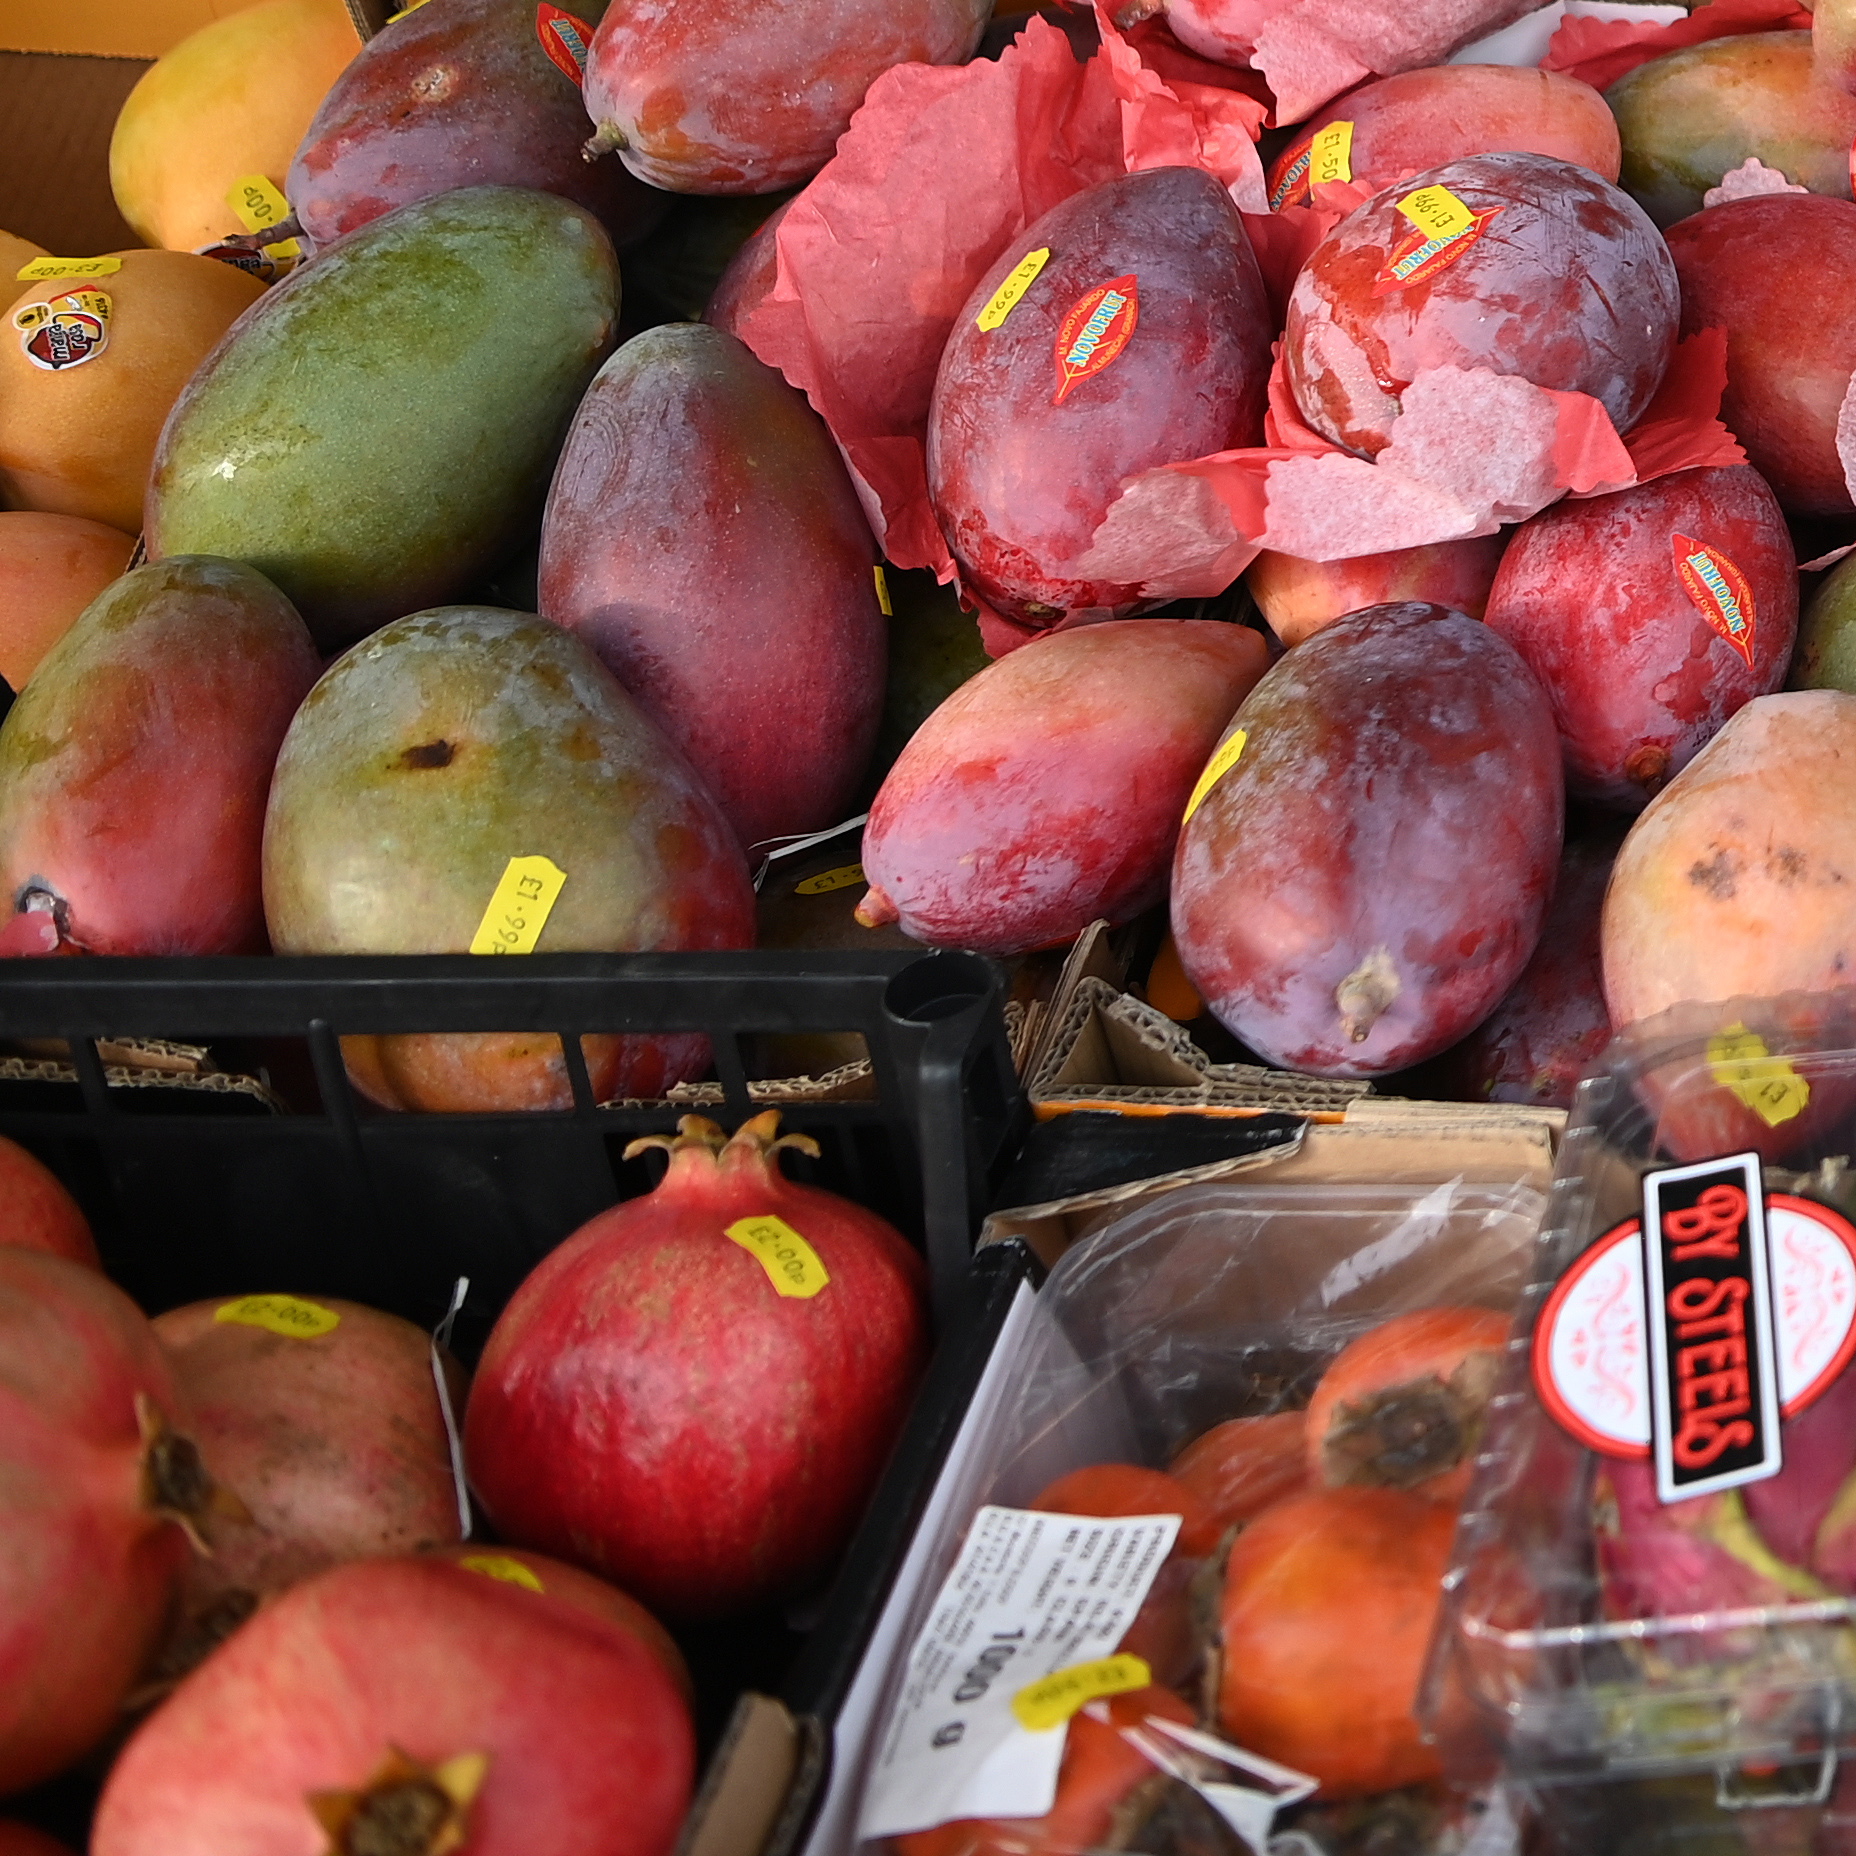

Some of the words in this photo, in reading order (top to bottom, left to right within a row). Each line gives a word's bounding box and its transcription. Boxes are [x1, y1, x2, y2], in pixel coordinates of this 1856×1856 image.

[1065, 289, 1128, 368] NOVOFRUT
[1684, 550, 1749, 636] NOVOFRUT
[1663, 1182, 1748, 1264] BY
[1670, 1275, 1754, 1469] STEELS
